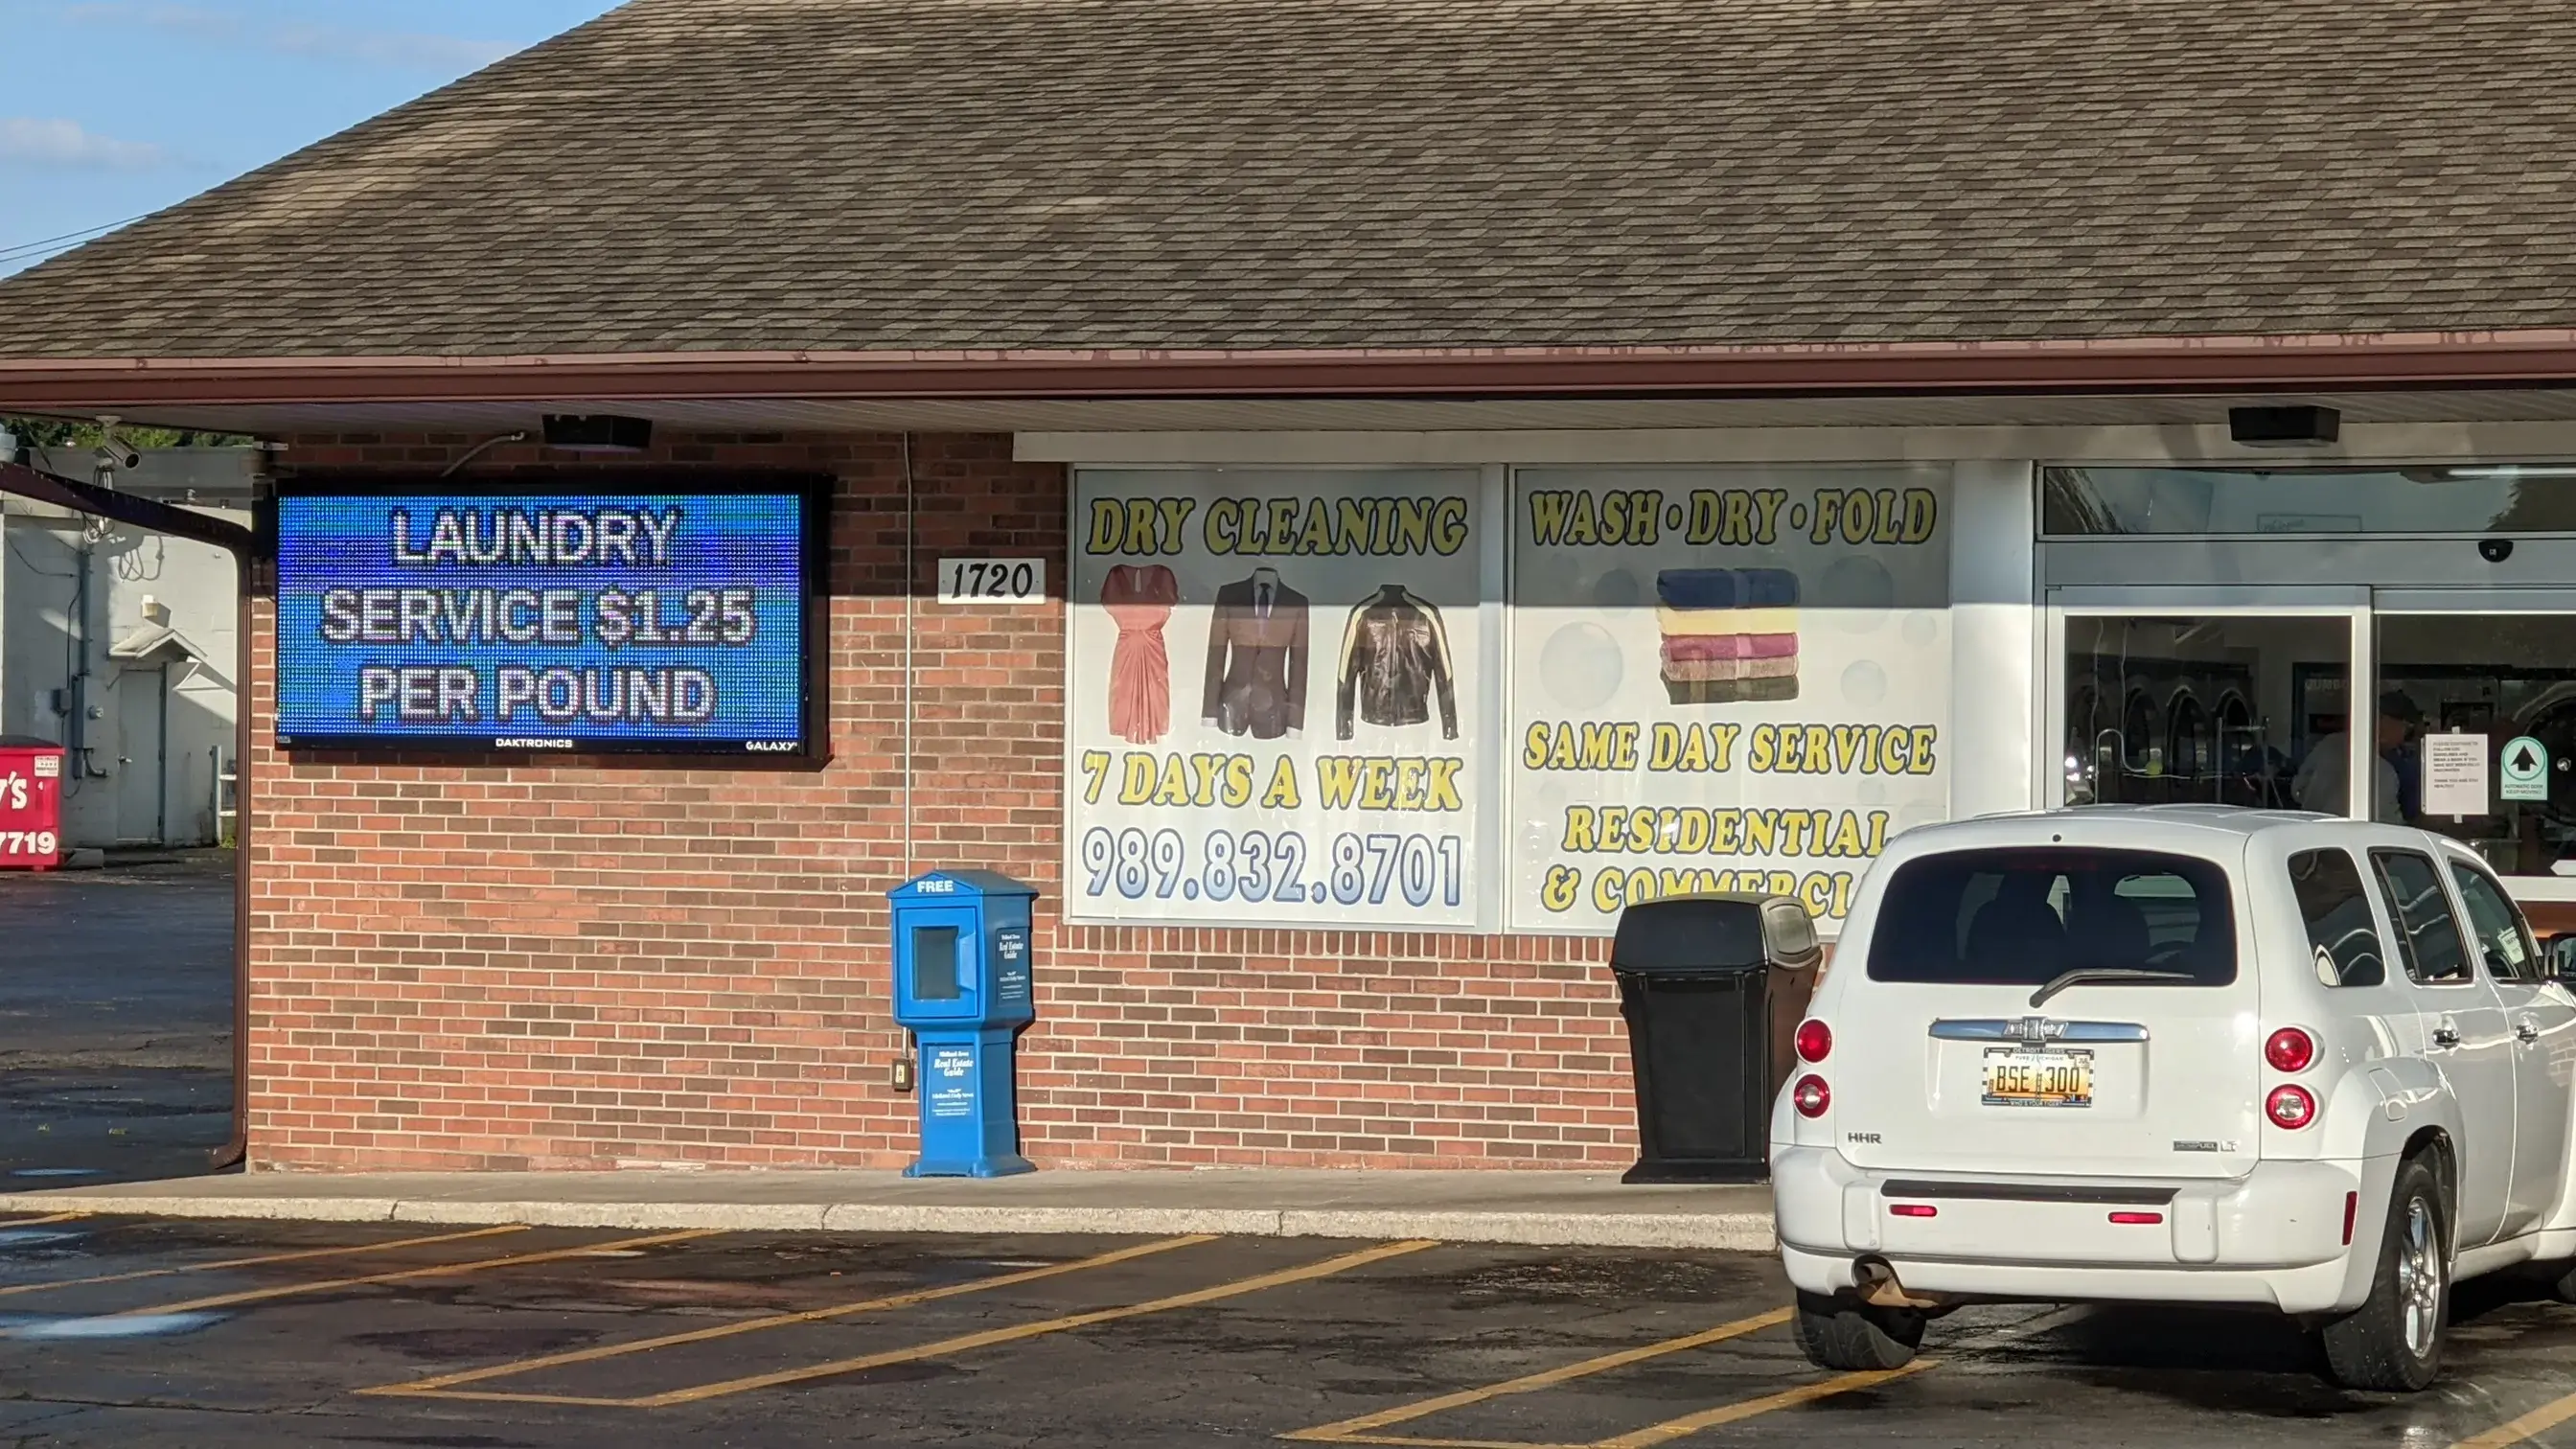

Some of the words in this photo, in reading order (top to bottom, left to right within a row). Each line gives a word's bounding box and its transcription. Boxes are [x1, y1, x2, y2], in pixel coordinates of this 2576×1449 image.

[393, 510, 681, 564] LAUNDRY
[1086, 496, 1196, 556] DRY
[1204, 496, 1468, 557] CLEANING
[1529, 489, 1664, 546] WASH
[1685, 489, 1788, 546] DRY
[1809, 488, 1937, 545] FOLD
[952, 563, 1033, 599] 1720
[323, 587, 581, 643] SERVICE
[595, 584, 757, 648] $1.25
[360, 667, 478, 719] PER
[497, 667, 717, 721] POUND
[495, 738, 573, 748] DAKTRONICS
[746, 741, 795, 751] GALAXY
[1523, 721, 1640, 771] SAME
[1647, 721, 1741, 772] DAY
[1748, 723, 1937, 775] SERVICE
[1081, 748, 1112, 806] 7
[1118, 751, 1254, 809] DAYS
[1260, 753, 1301, 810] A
[1316, 755, 1464, 812] WEEK
[1561, 805, 1894, 859] RESIDENTIAL
[917, 880, 954, 893] FREE
[1081, 825, 1462, 907] 989.832.8701
[1540, 863, 1581, 912] &
[933, 1058, 952, 1068] Real
[952, 1058, 975, 1068] Estate
[944, 1068, 964, 1076] Guide
[1996, 1066, 2030, 1092] BSE
[2045, 1067, 2080, 1092] 300
[1848, 1132, 1882, 1144] HHR
